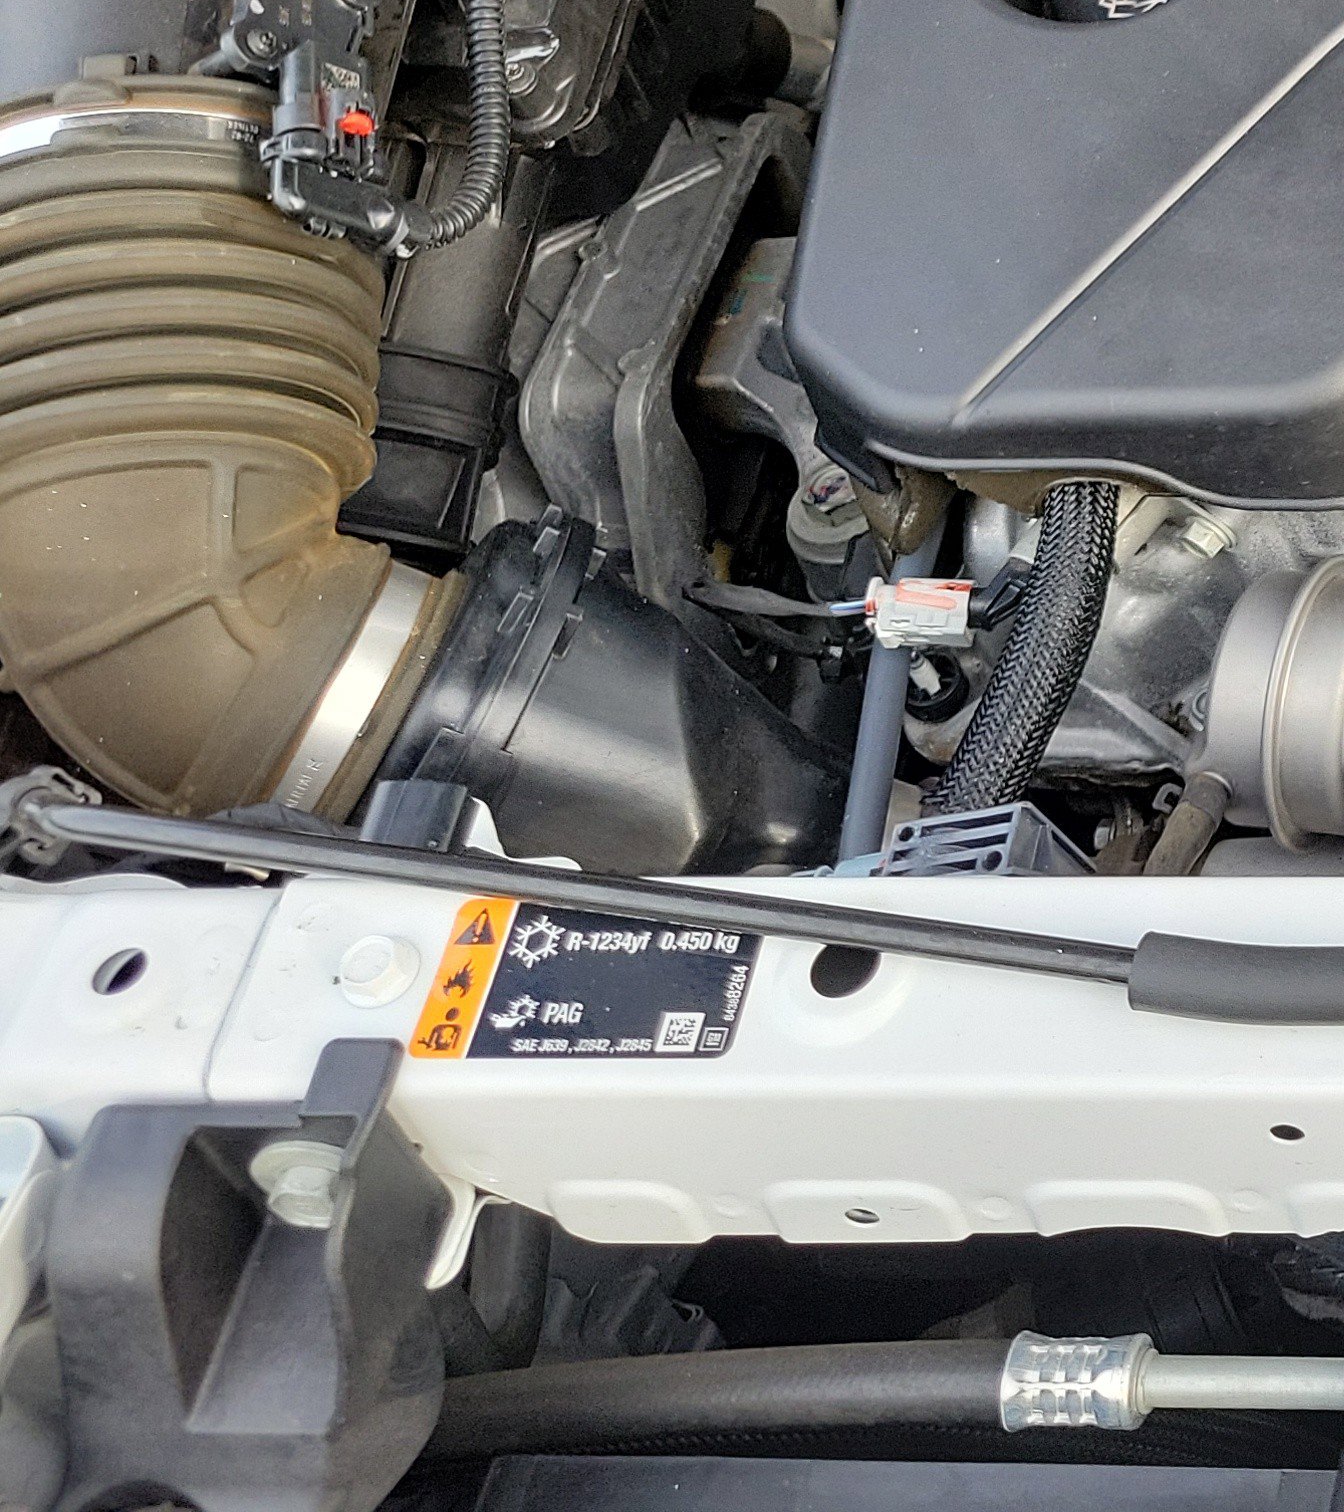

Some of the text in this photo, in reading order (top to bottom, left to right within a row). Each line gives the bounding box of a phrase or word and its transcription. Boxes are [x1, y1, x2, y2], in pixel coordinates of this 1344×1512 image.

[565, 931, 741, 954] R-1234yf 0.450 kg
[541, 1002, 584, 1025] PAG
[512, 1038, 538, 1051] SAE
